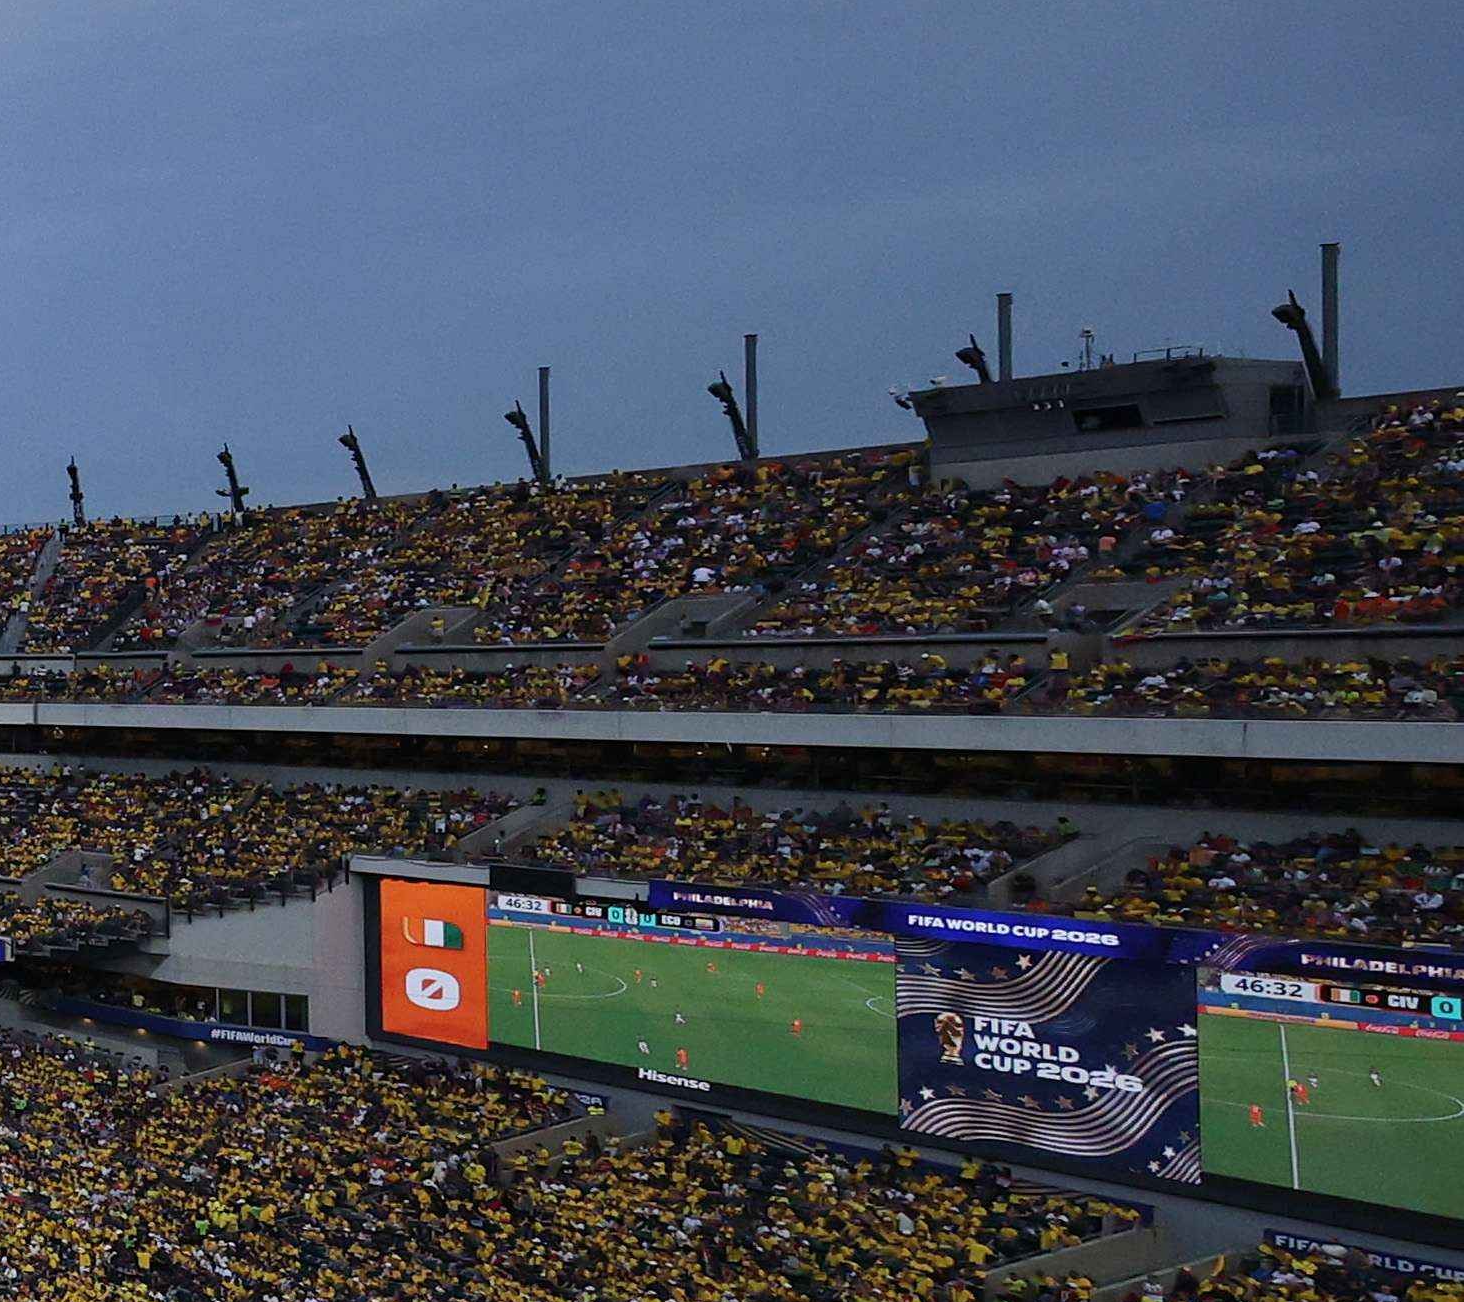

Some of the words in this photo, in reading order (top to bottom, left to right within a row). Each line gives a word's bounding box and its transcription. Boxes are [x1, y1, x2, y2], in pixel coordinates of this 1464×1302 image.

[505, 896, 542, 913] 46:32
[673, 892, 773, 911] PHILADELPHIA
[908, 914, 944, 928] FIFA
[946, 919, 1010, 935] WORLD
[1012, 925, 1049, 939] CUP
[1051, 928, 1120, 947] 2026
[1234, 978, 1303, 999] 46:32
[1387, 995, 1419, 1010] CIV
[974, 1016, 1035, 1039] FIFA
[974, 1033, 1080, 1063] WORLD
[638, 1068, 710, 1092] Hisense
[975, 1053, 1032, 1074] CUP
[1036, 1062, 1144, 1093] 2026
